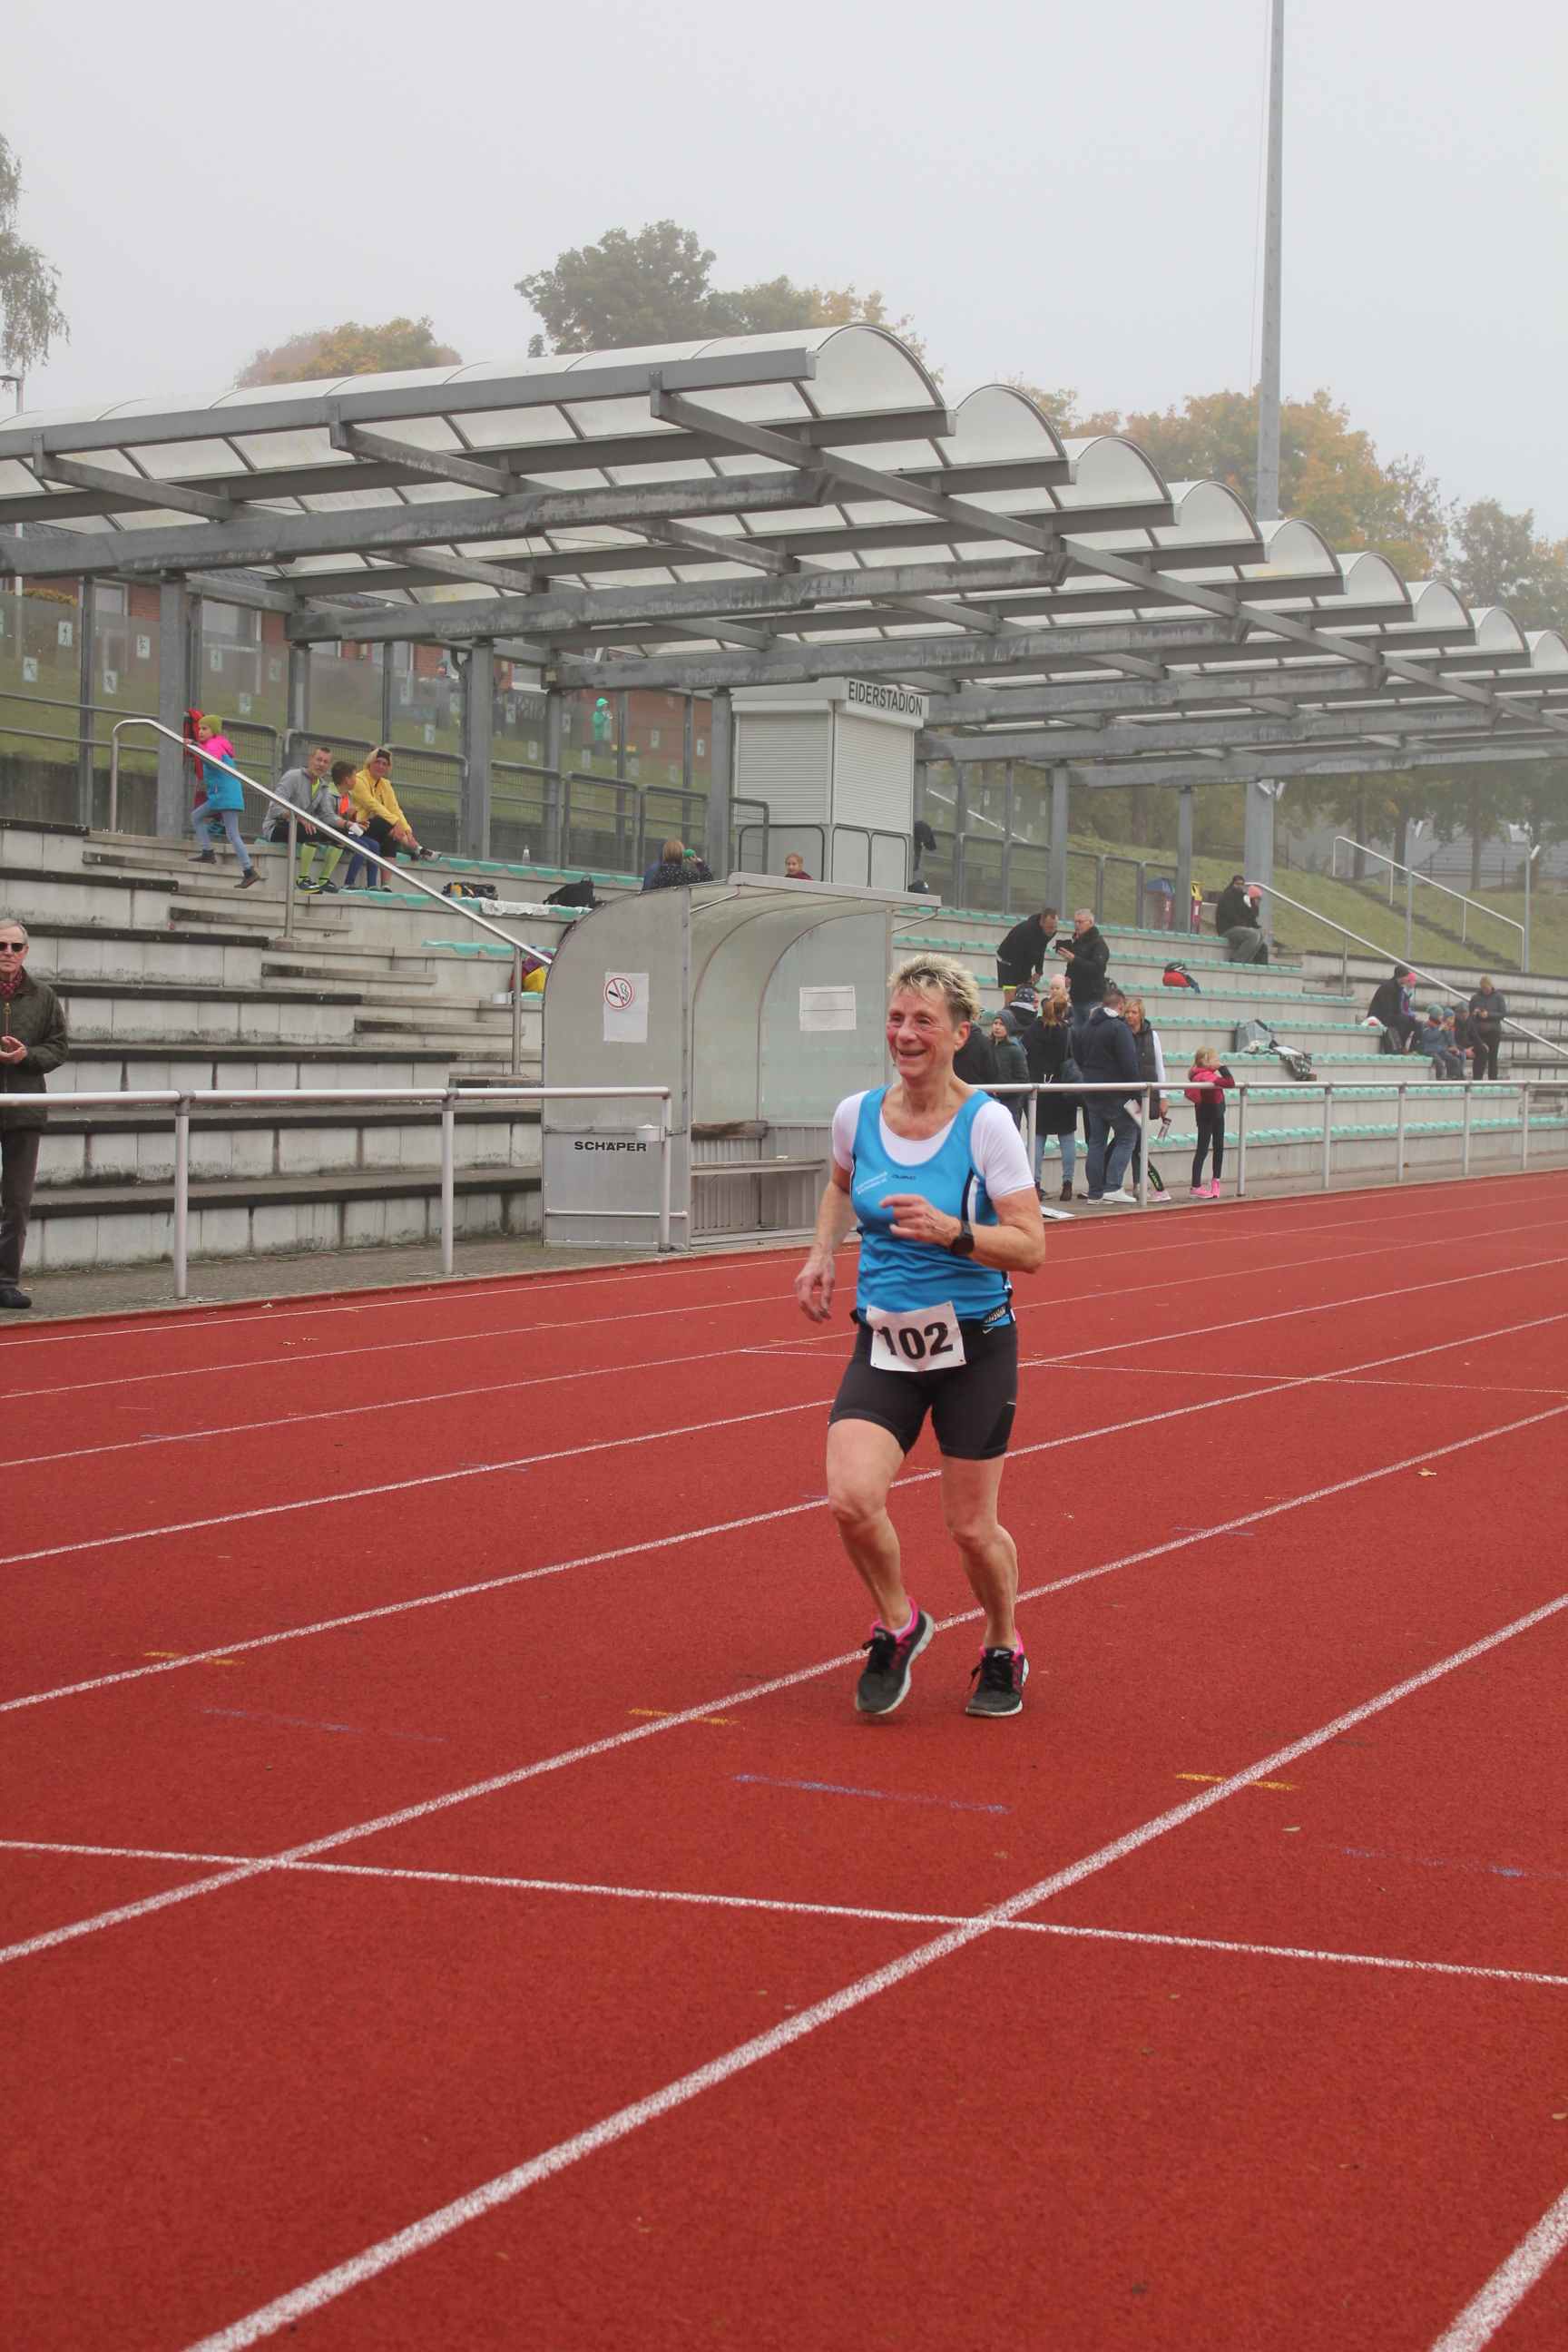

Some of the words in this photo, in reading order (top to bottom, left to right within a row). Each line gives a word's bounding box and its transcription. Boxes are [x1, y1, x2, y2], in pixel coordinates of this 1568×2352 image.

[848, 681, 923, 717] EIDERSTADION
[574, 1141, 647, 1152] SCHÄPER
[877, 1322, 954, 1359] 102
